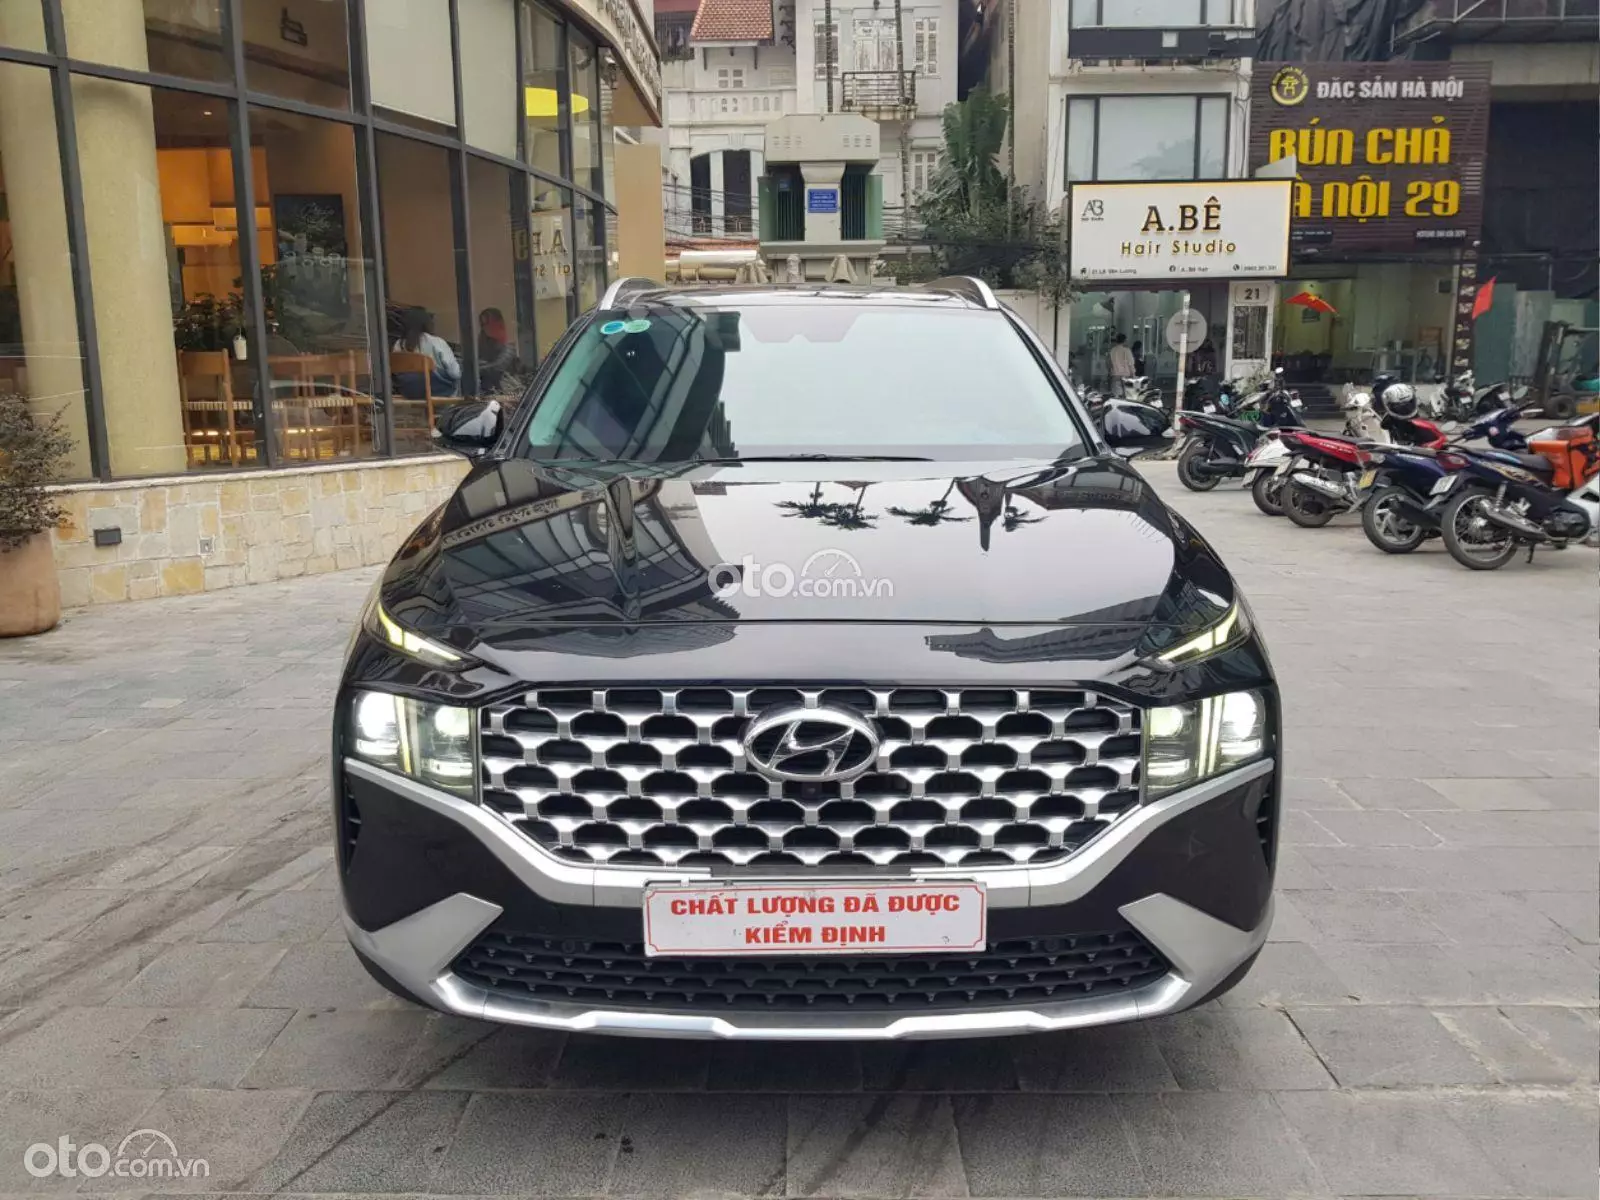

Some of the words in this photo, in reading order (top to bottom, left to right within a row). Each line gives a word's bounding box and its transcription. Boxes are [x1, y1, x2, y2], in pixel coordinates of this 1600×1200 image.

[1359, 75, 1397, 98] SẢN
[1432, 76, 1464, 101] NỘI
[1366, 116, 1450, 164] CHẢ
[1322, 175, 1390, 222] NỘI
[1404, 180, 1460, 216] 29
[1141, 196, 1221, 232] A.BÊ
[1121, 241, 1161, 255] Hair
[1172, 240, 1236, 254] Studio
[1244, 287, 1260, 300] 21
[670, 893, 738, 916] CHẤT
[747, 896, 835, 917] LƯỢNG
[843, 893, 880, 913] ĐÃ
[887, 893, 960, 915] ĐƯỢC
[745, 920, 812, 944] KIỂM
[821, 926, 886, 946] ĐỊNH
